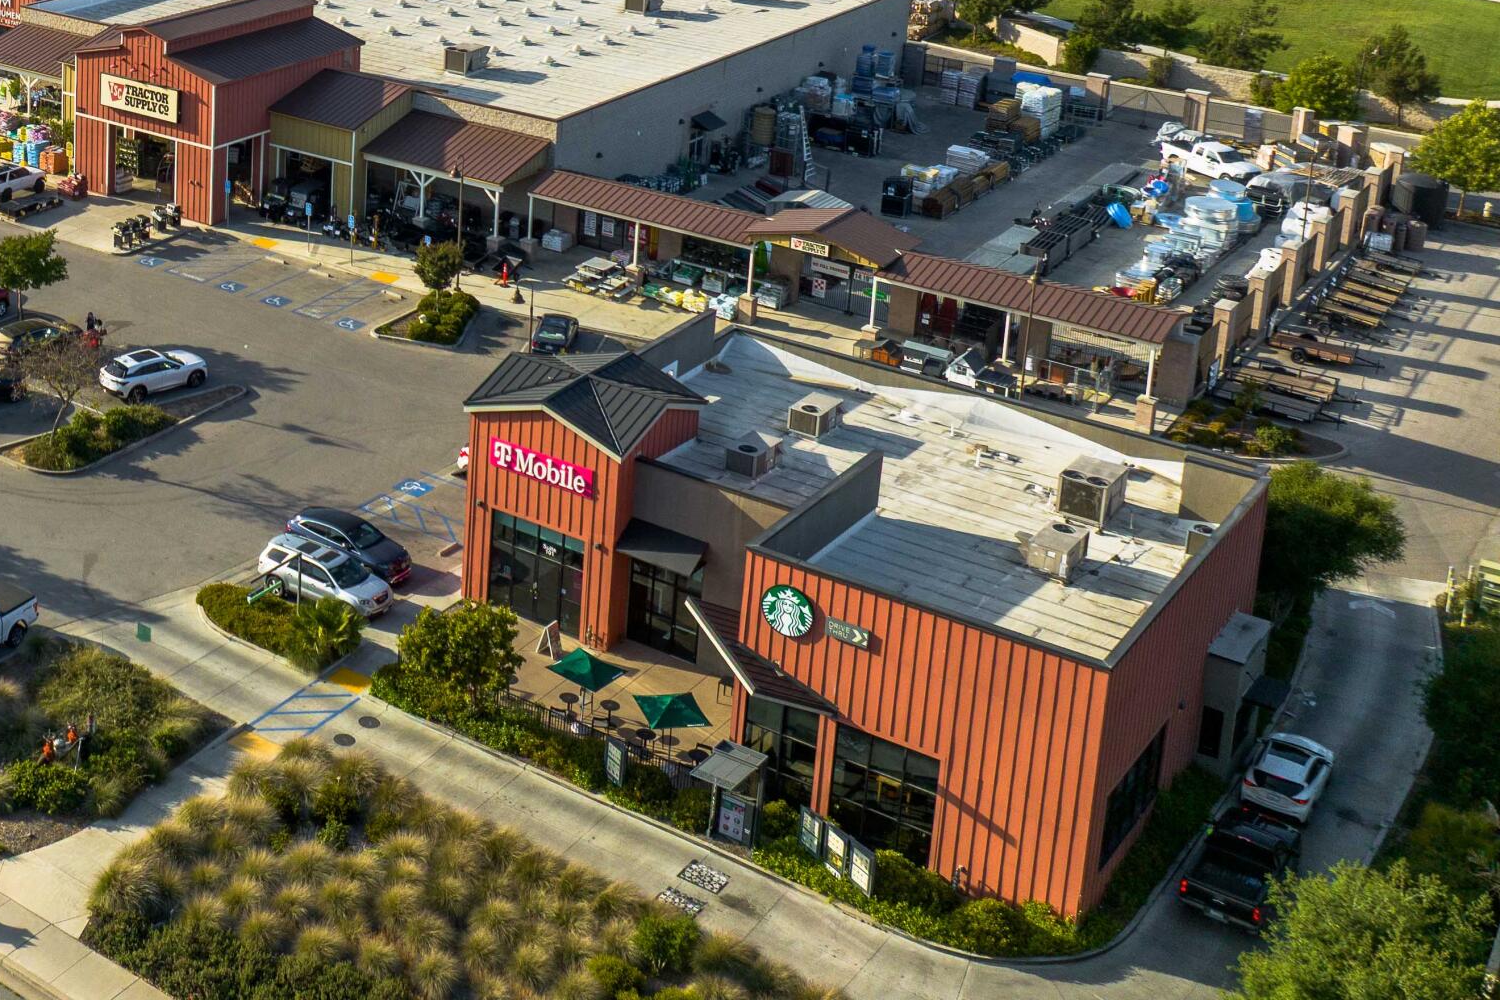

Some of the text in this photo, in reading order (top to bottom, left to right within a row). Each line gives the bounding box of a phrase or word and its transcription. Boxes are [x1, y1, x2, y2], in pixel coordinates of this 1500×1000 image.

[108, 81, 123, 100] TSC
[125, 84, 169, 104] TRACTOR
[124, 95, 158, 113] SUPPLY
[514, 448, 585, 493] Mobile
[828, 621, 850, 634] DRIVE
[828, 629, 848, 639] THRU
